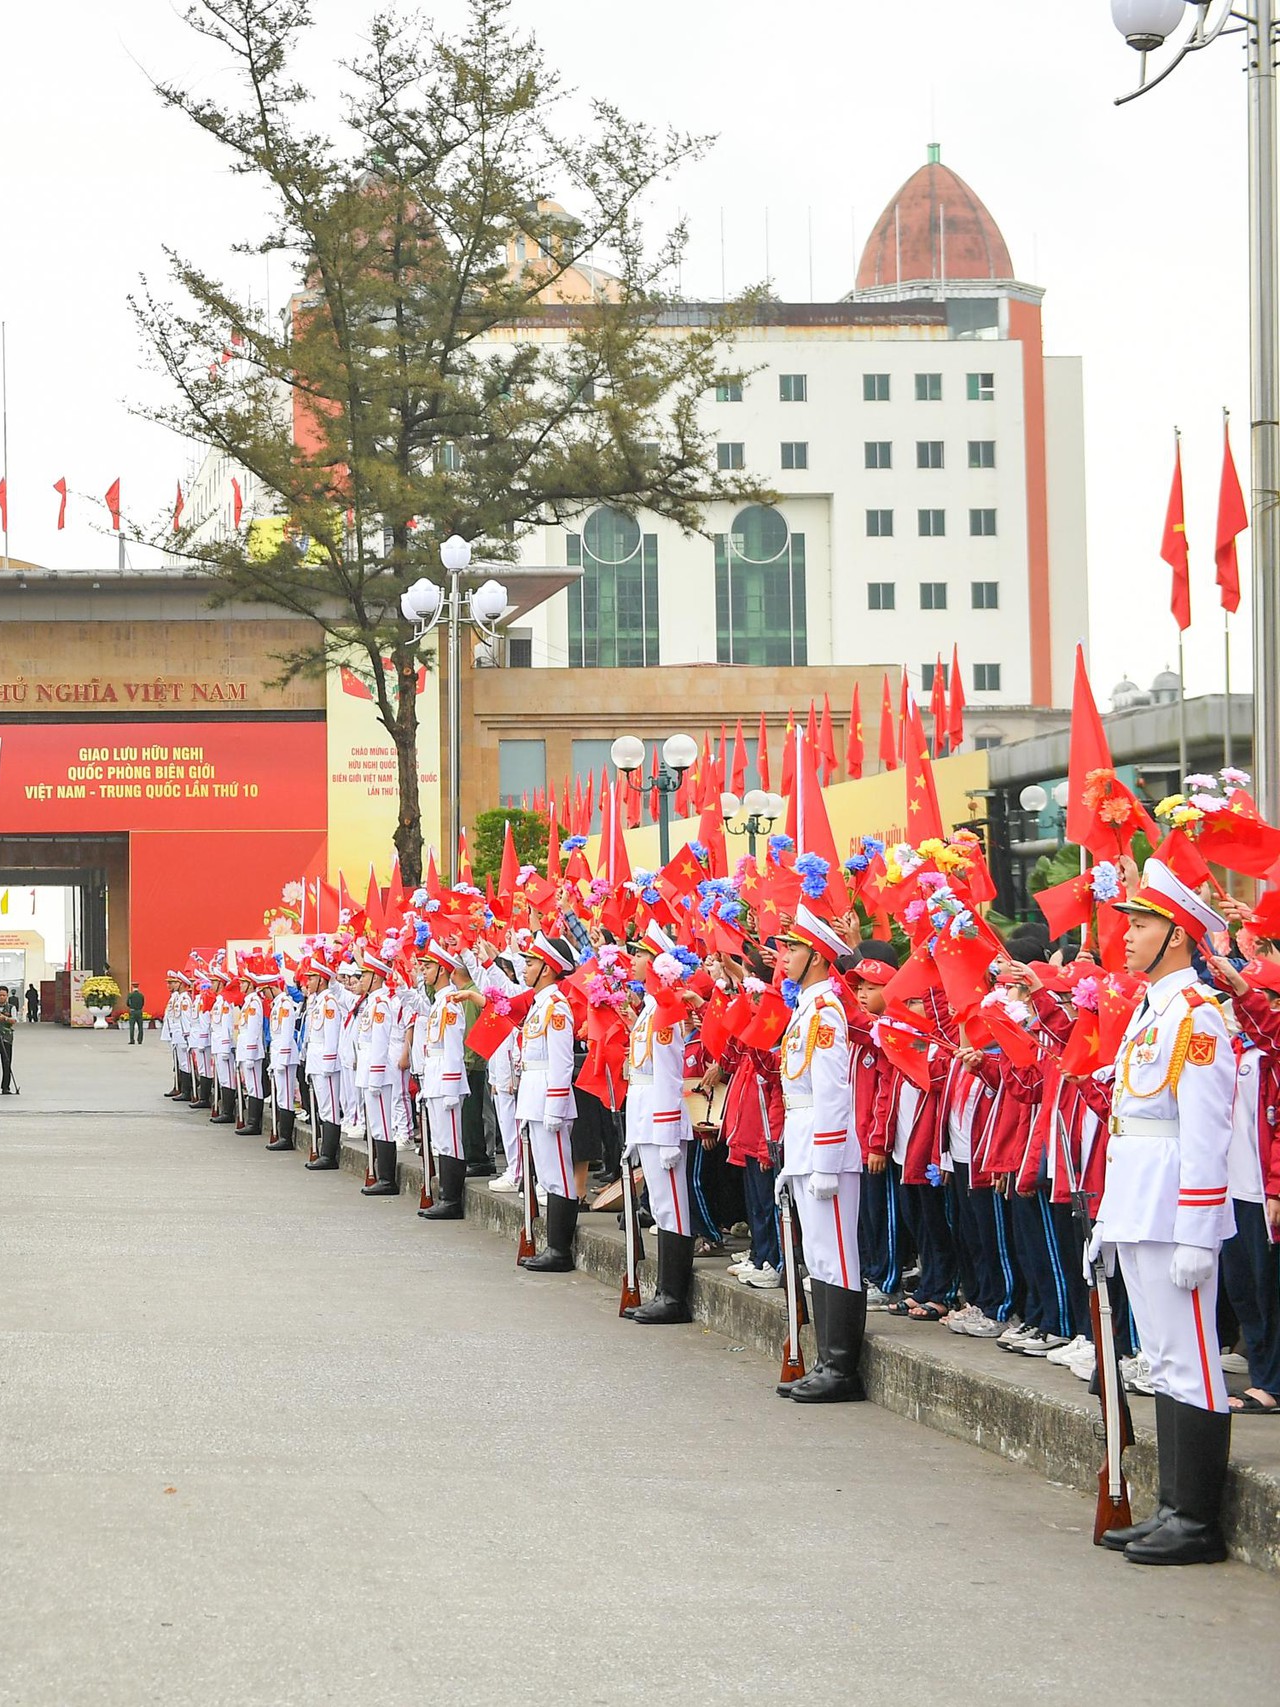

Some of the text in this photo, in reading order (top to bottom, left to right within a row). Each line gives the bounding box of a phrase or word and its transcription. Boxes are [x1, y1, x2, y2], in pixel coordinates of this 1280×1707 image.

[36, 678, 118, 702] NGHĨA
[123, 677, 184, 707] VIỆT
[191, 682, 247, 702] NAM
[79, 745, 204, 762] GIAO LƯU HỮU NGHỊ
[68, 762, 215, 780] QUỐC PHÒNG BIÊN GIỚI
[378, 774, 393, 783] NAM
[25, 783, 53, 801] VIỆT
[57, 785, 86, 798] NAM
[99, 784, 142, 798] TRUNG
[146, 781, 181, 799] QUỐC
[185, 780, 210, 798] LẦN
[213, 782, 239, 797] THỨ
[242, 784, 259, 797] 10
